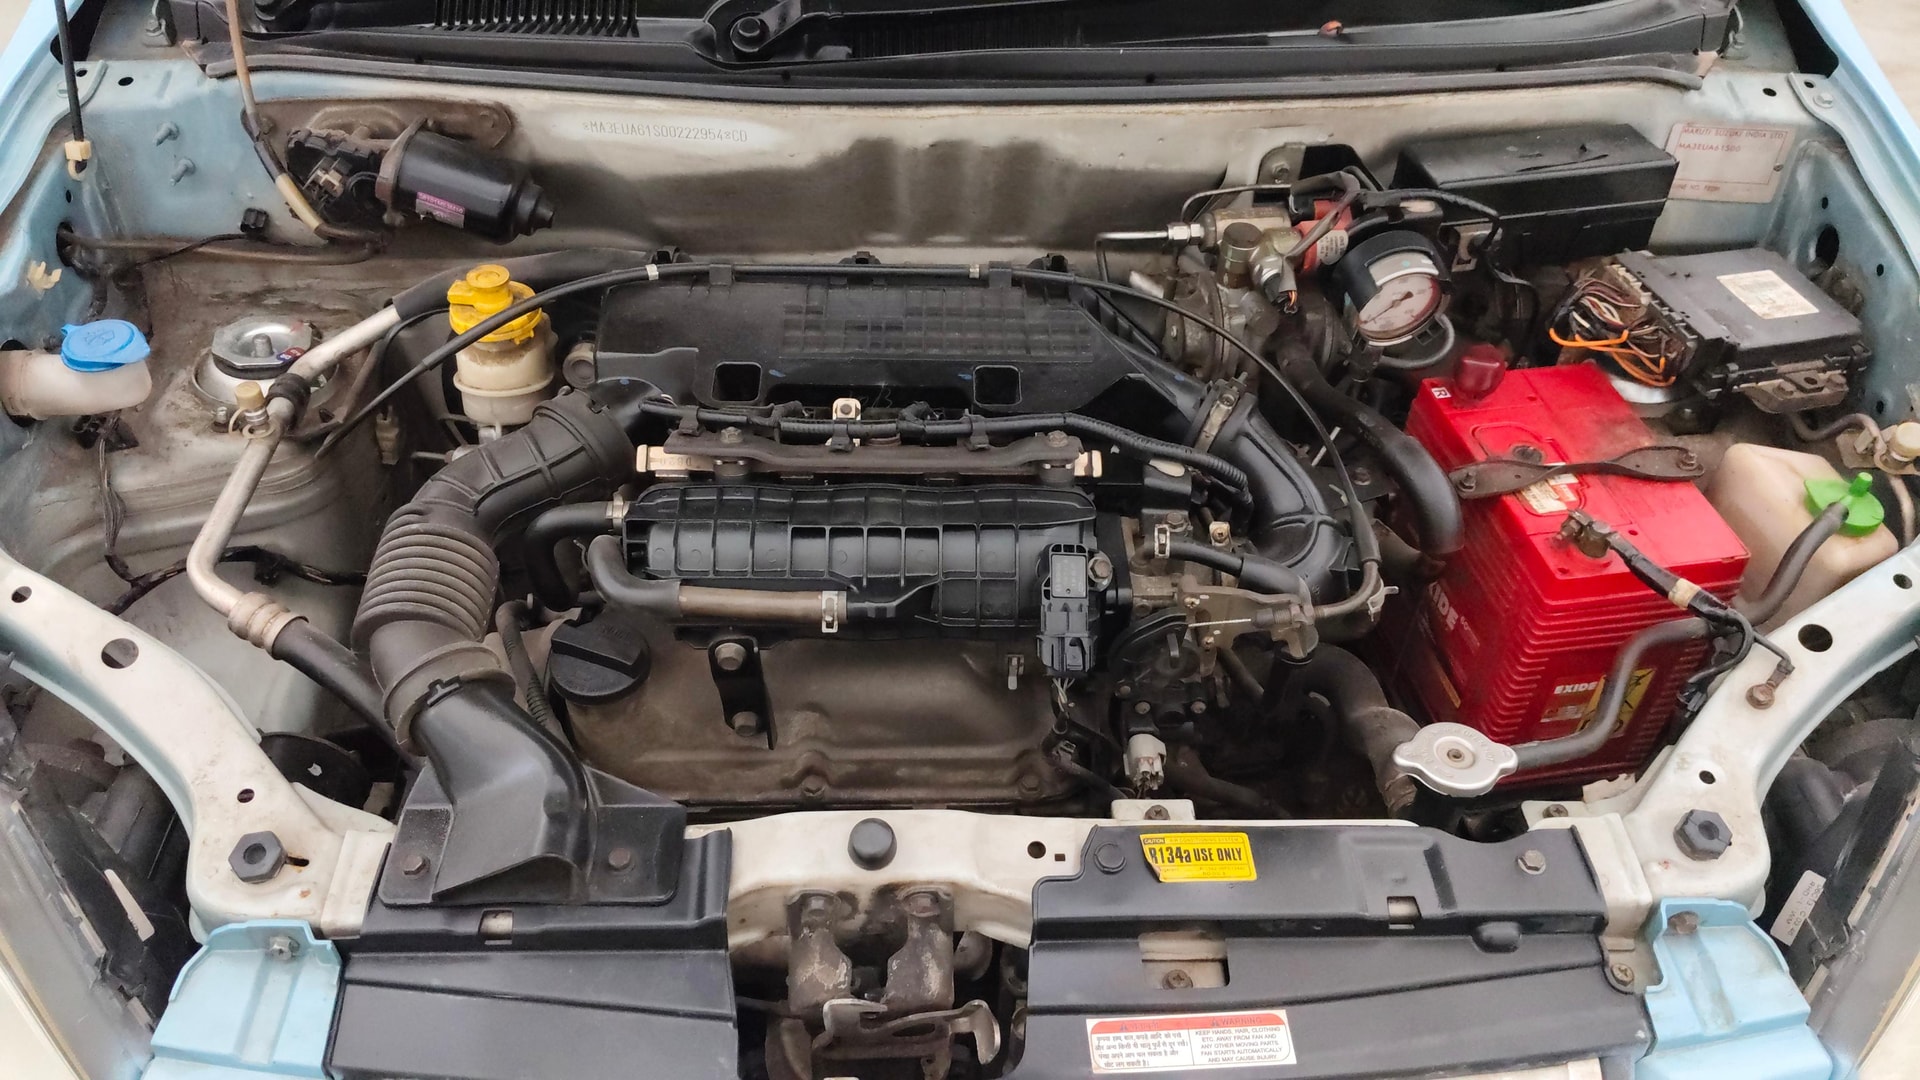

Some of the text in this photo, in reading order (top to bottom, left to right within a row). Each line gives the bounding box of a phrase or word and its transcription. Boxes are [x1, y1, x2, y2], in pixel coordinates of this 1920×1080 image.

[1435, 389, 1448, 398] R
[1554, 682, 1598, 694] EXIDE
[1148, 846, 1242, 864] R134a USE ONLY
[1221, 1017, 1262, 1025] WARNING
